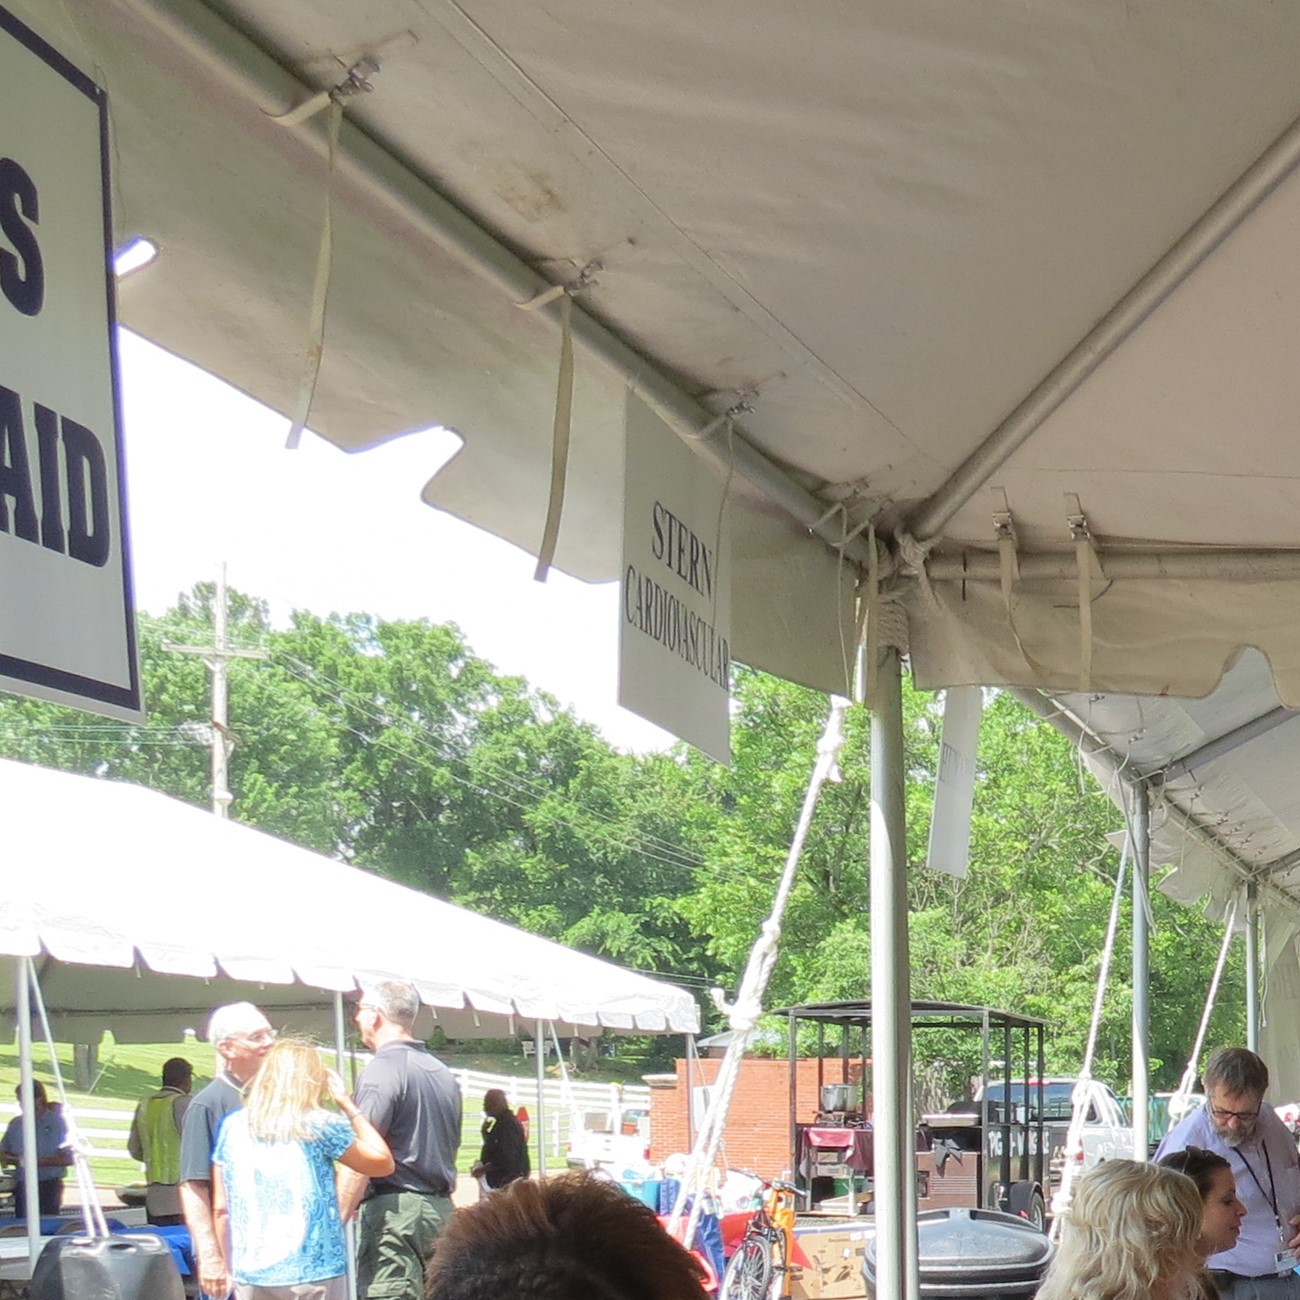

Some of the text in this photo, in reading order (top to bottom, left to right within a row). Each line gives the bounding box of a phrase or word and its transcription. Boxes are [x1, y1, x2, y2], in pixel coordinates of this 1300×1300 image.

[0, 385, 111, 568] AID
[652, 501, 713, 599] STERN
[625, 565, 730, 692] CARDIOVASCULAR
